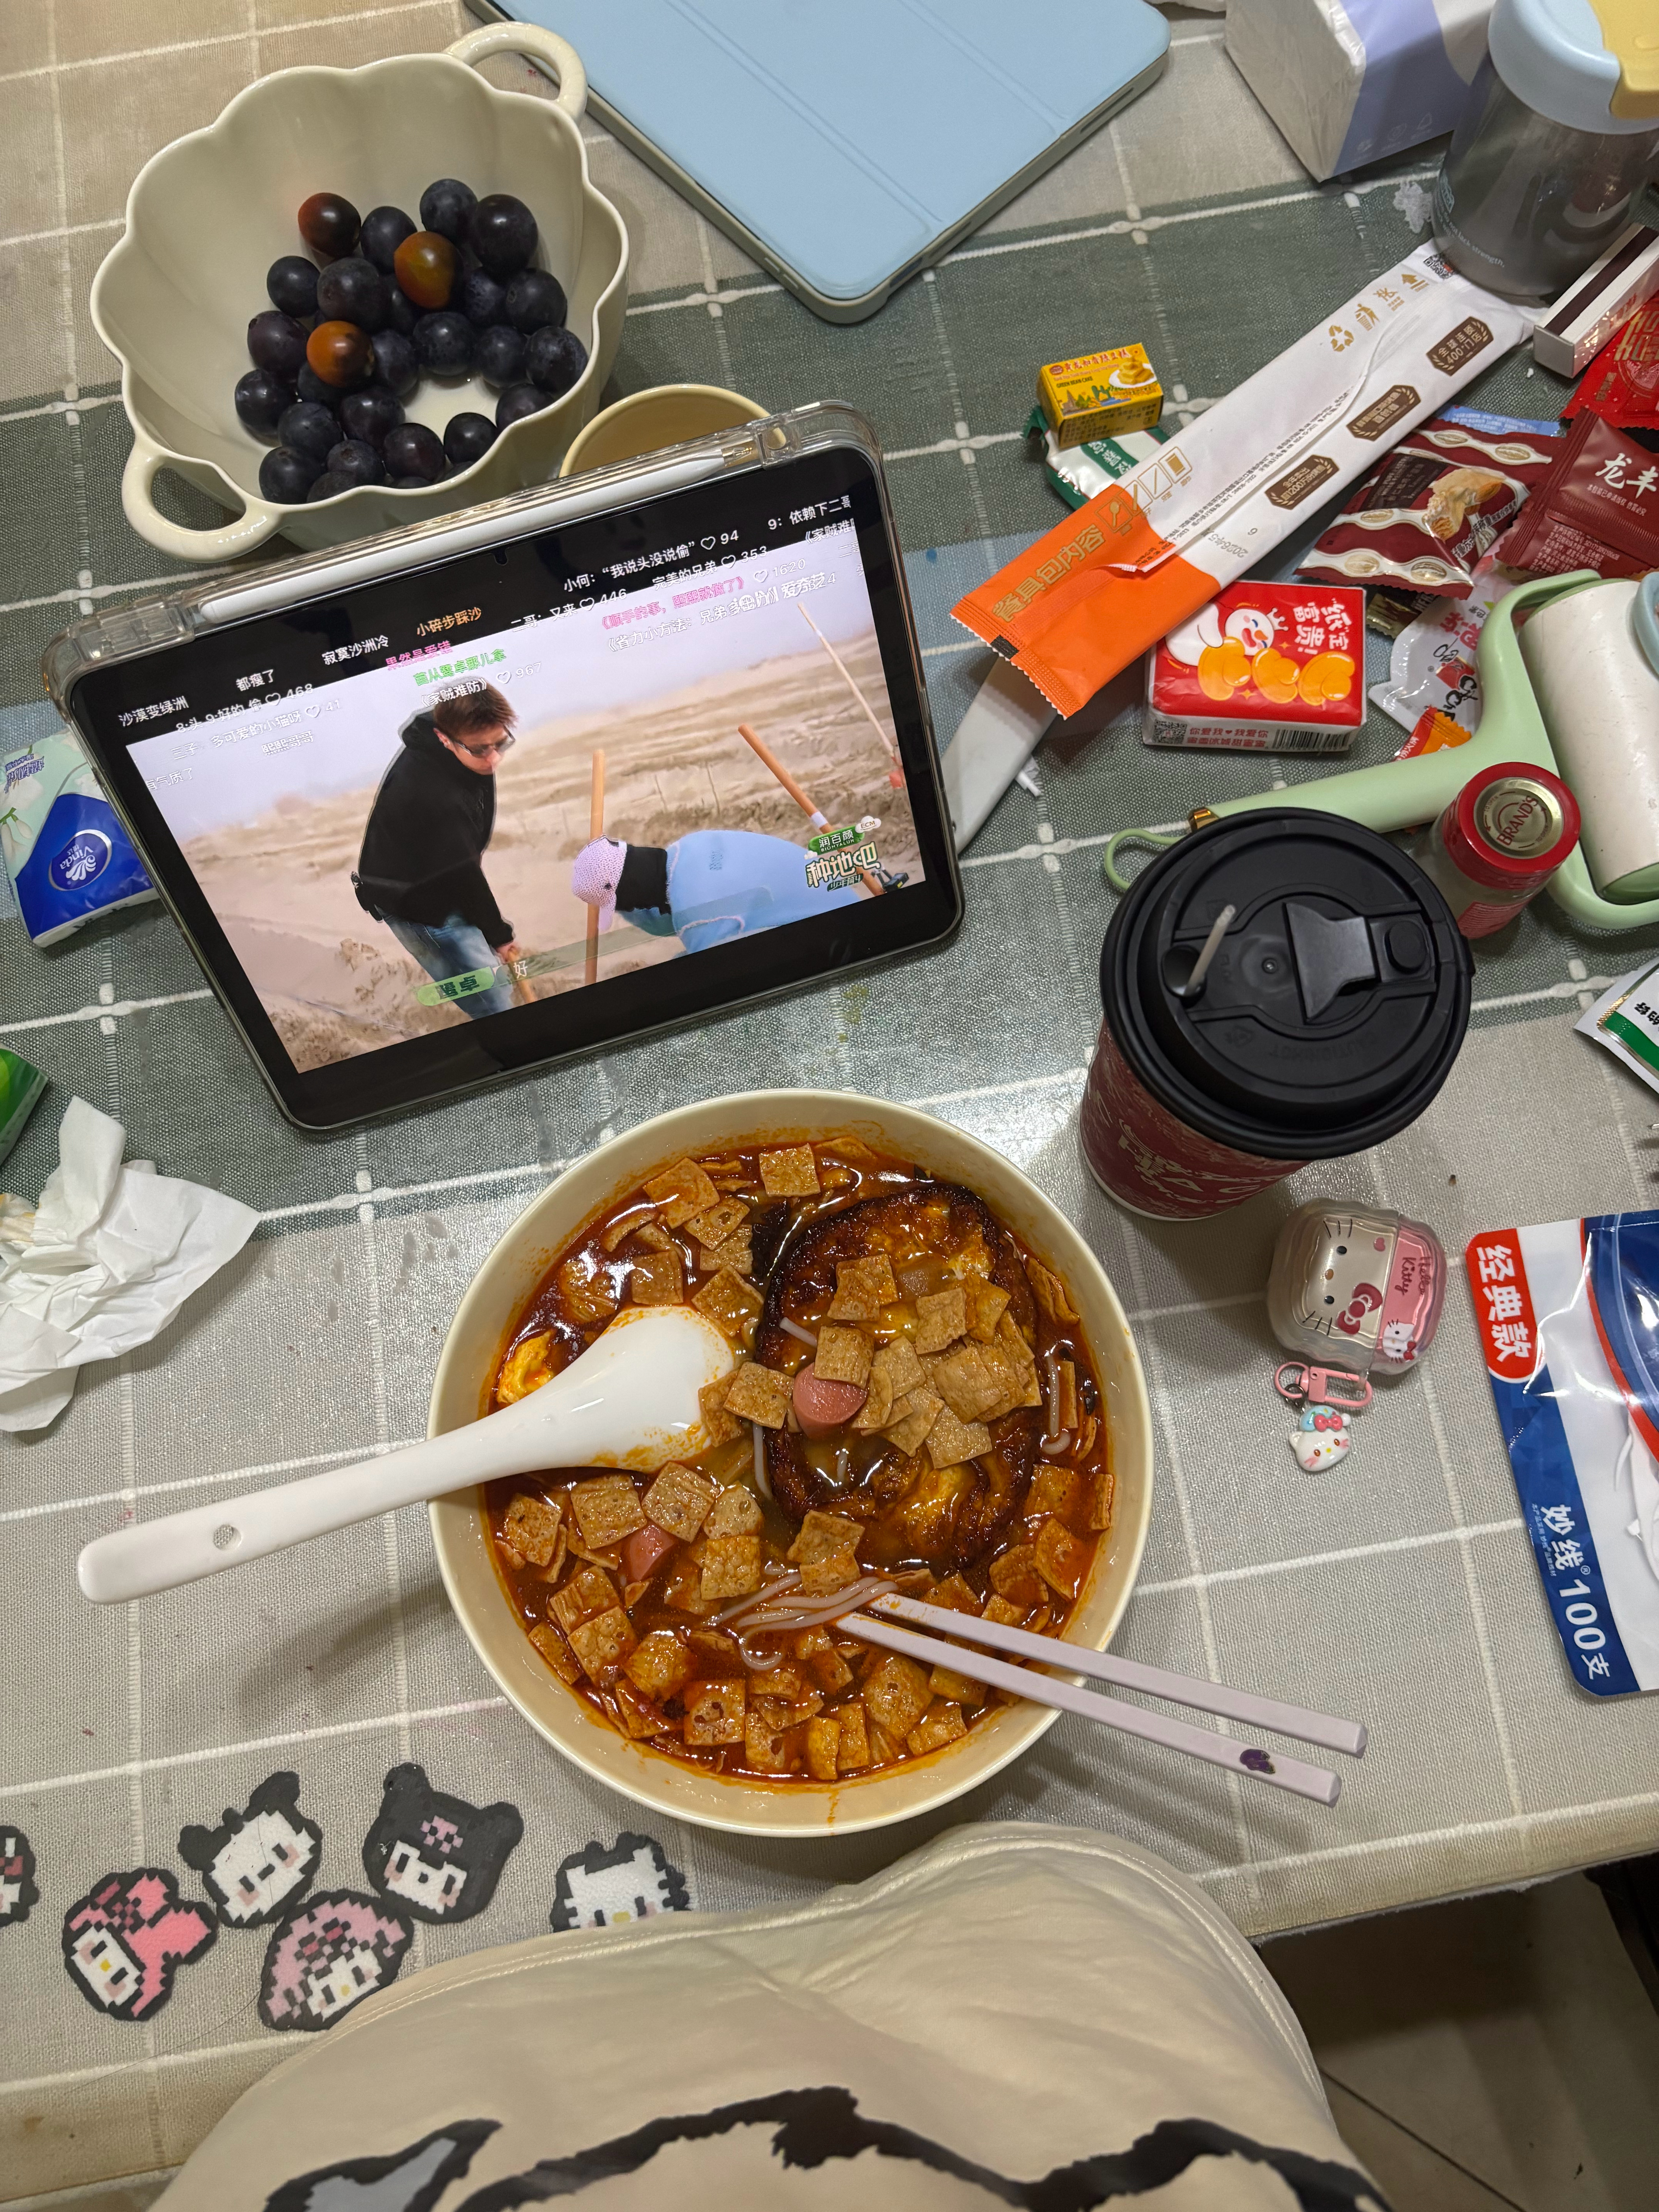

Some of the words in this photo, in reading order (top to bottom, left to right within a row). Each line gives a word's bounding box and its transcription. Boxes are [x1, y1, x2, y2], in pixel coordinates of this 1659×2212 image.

[1472, 246, 1505, 268] strength,
[720, 529, 739, 545] 94
[652, 560, 718, 591] 完美的兄弟
[740, 546, 767, 563] 353
[773, 558, 805, 577] 1620
[992, 524, 1106, 622] 餐具包内容
[600, 589, 627, 605] 446
[417, 606, 482, 637] 小碎步踩沙
[321, 635, 389, 665] 寂寞沙洲冷
[236, 669, 274, 692] 都瘦了
[422, 678, 488, 708] 《家贼难防》
[515, 662, 542, 679] 967
[118, 696, 189, 728] 沙漠变绿洲
[248, 699, 262, 713] 偷
[285, 684, 313, 699] 468
[210, 710, 302, 749] 多可爱的小猫呀
[325, 699, 340, 712] 41
[1190, 727, 1223, 736] 你爱我
[1234, 729, 1269, 738] 我爱你
[1187, 737, 1266, 748] 蜜雪冰城甜蜜蜜
[860, 821, 876, 829] ECM
[1496, 795, 1539, 846] BRAND'S
[819, 830, 854, 848] 润百颜
[60, 845, 93, 870] Vinda
[807, 843, 881, 887] 种地吧
[513, 960, 527, 979] 好
[1394, 1256, 1417, 1296] Kitty
[1418, 1256, 1433, 1295] Hello
[1477, 1243, 1531, 1362] 经典款
[1559, 1577, 1611, 1681] 100支
